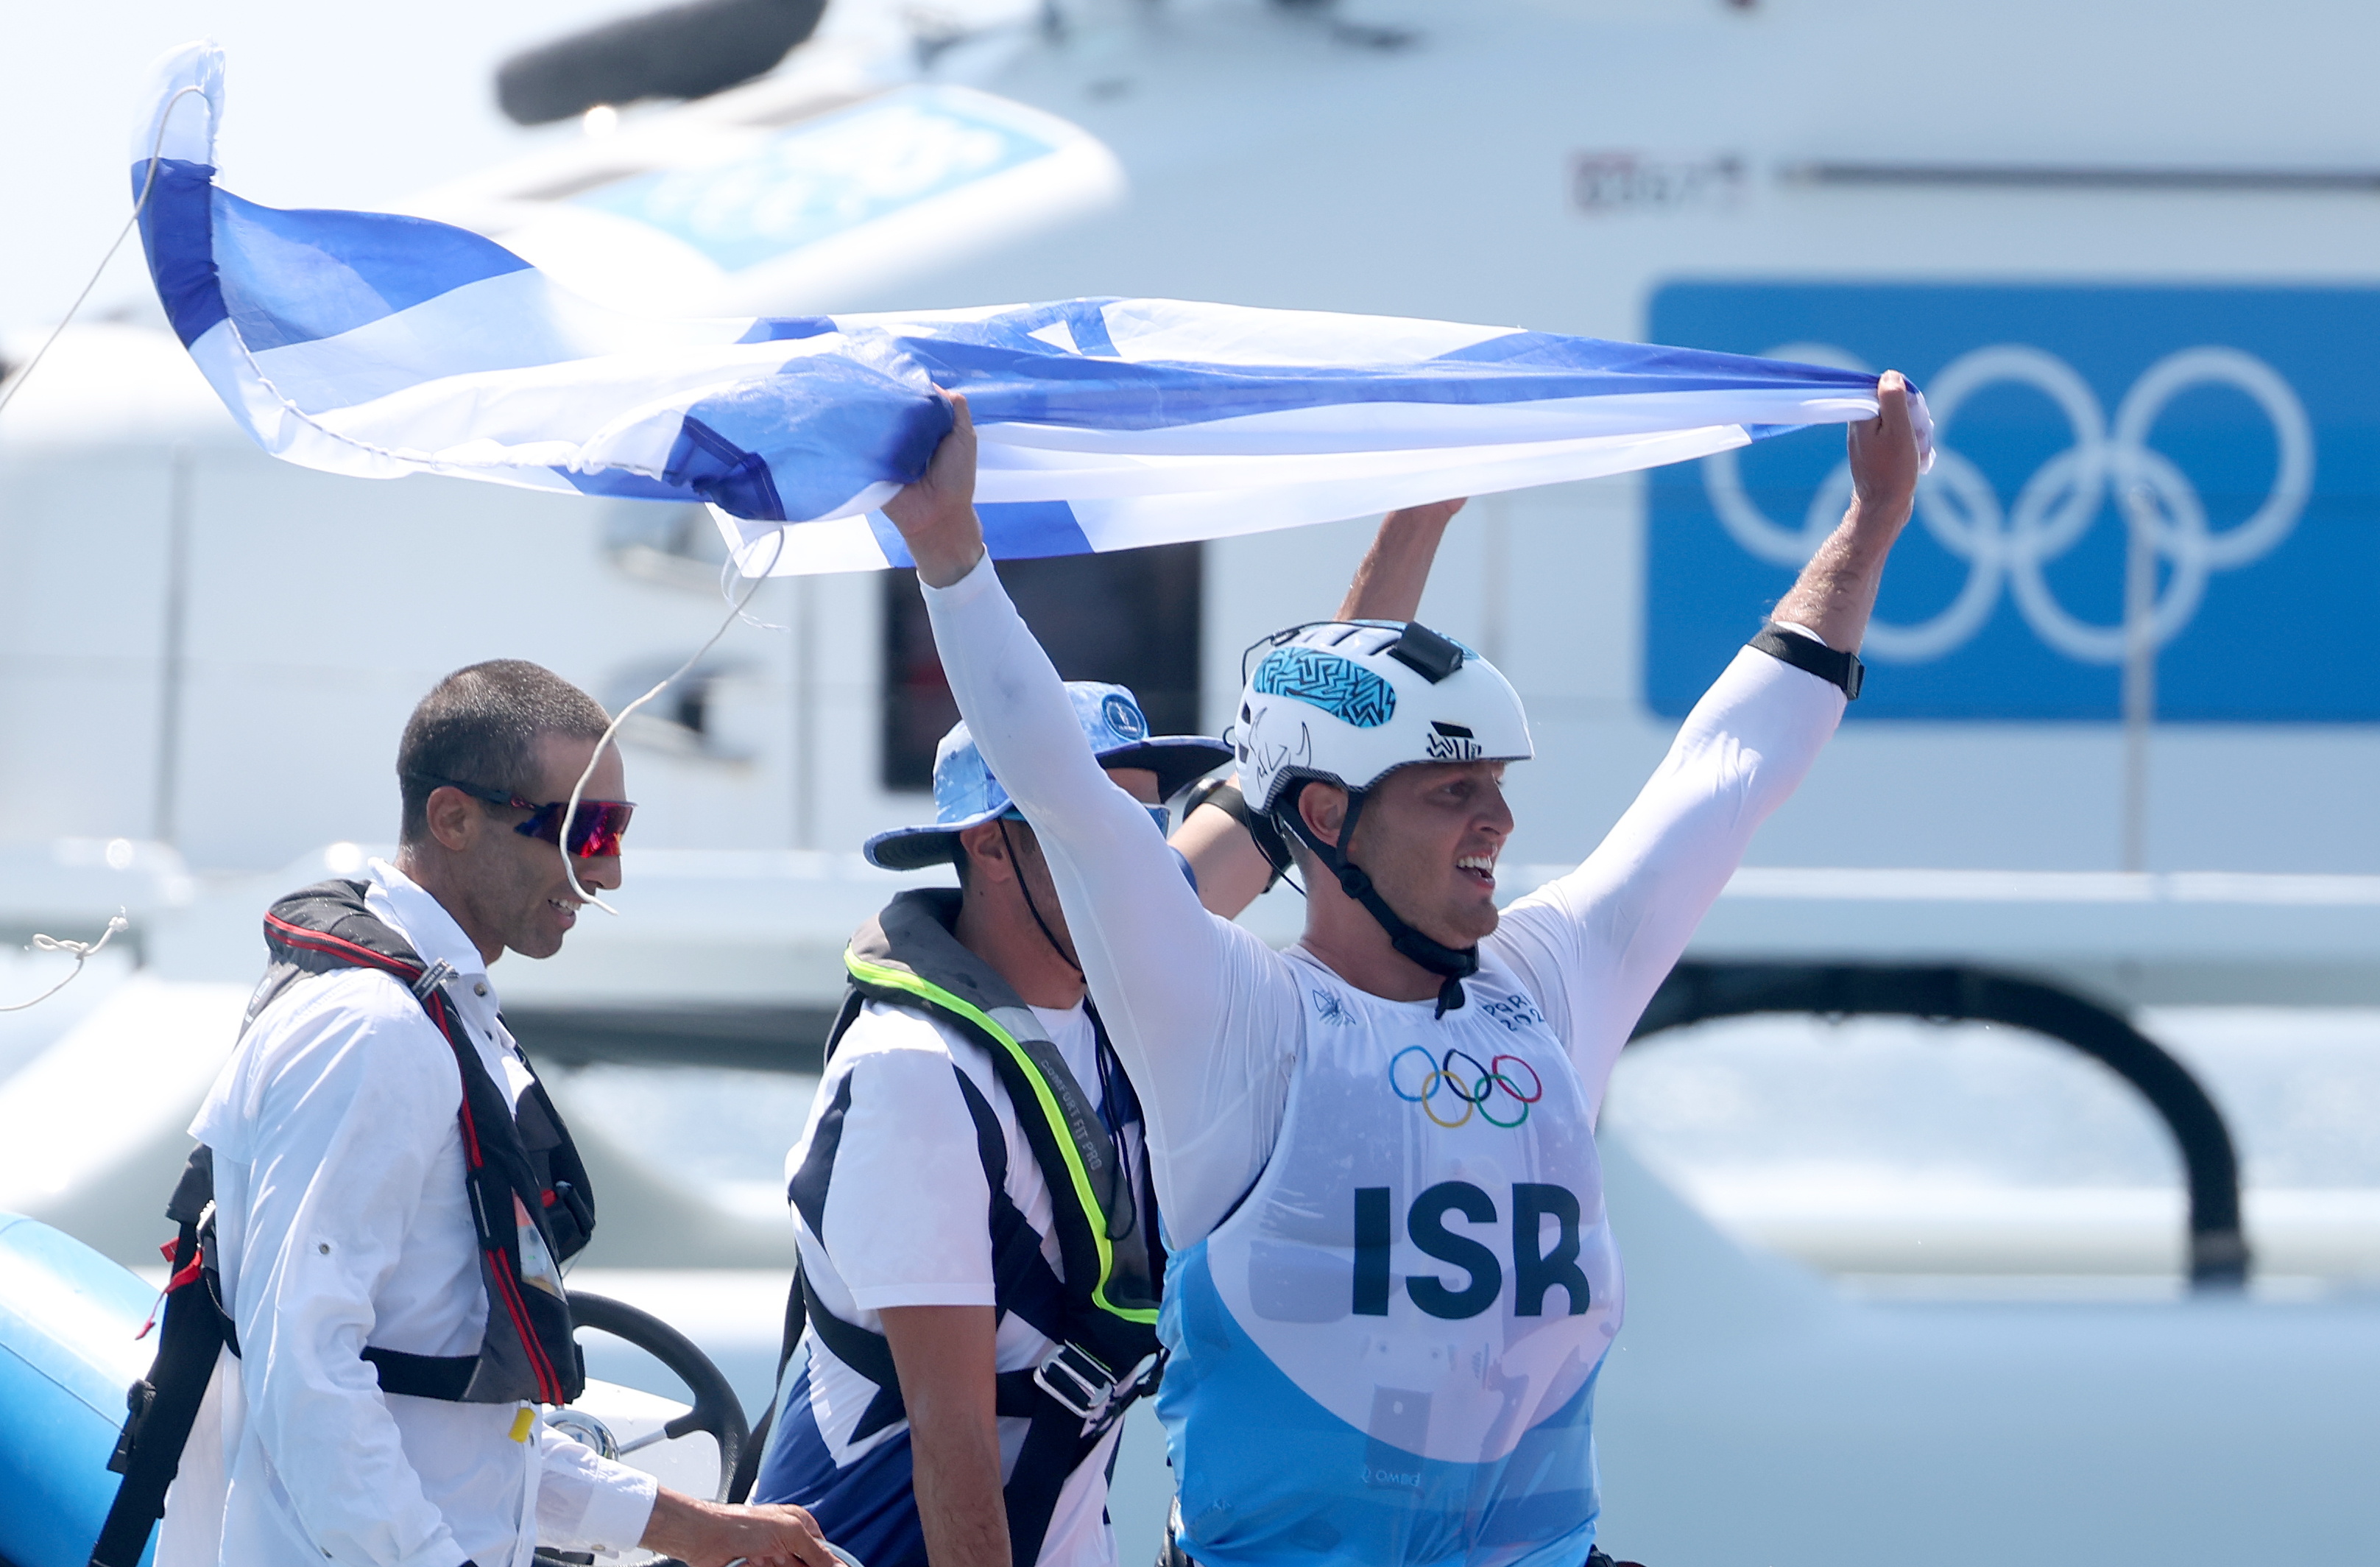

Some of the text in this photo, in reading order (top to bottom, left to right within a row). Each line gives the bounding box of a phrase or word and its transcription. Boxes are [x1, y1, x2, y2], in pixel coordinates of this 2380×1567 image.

[1482, 991, 1532, 1016] PARI
[1500, 1007, 1545, 1032] 202
[1040, 1059, 1103, 1171] COMFORT FIT PRO
[1352, 1180, 1590, 1319] ISR
